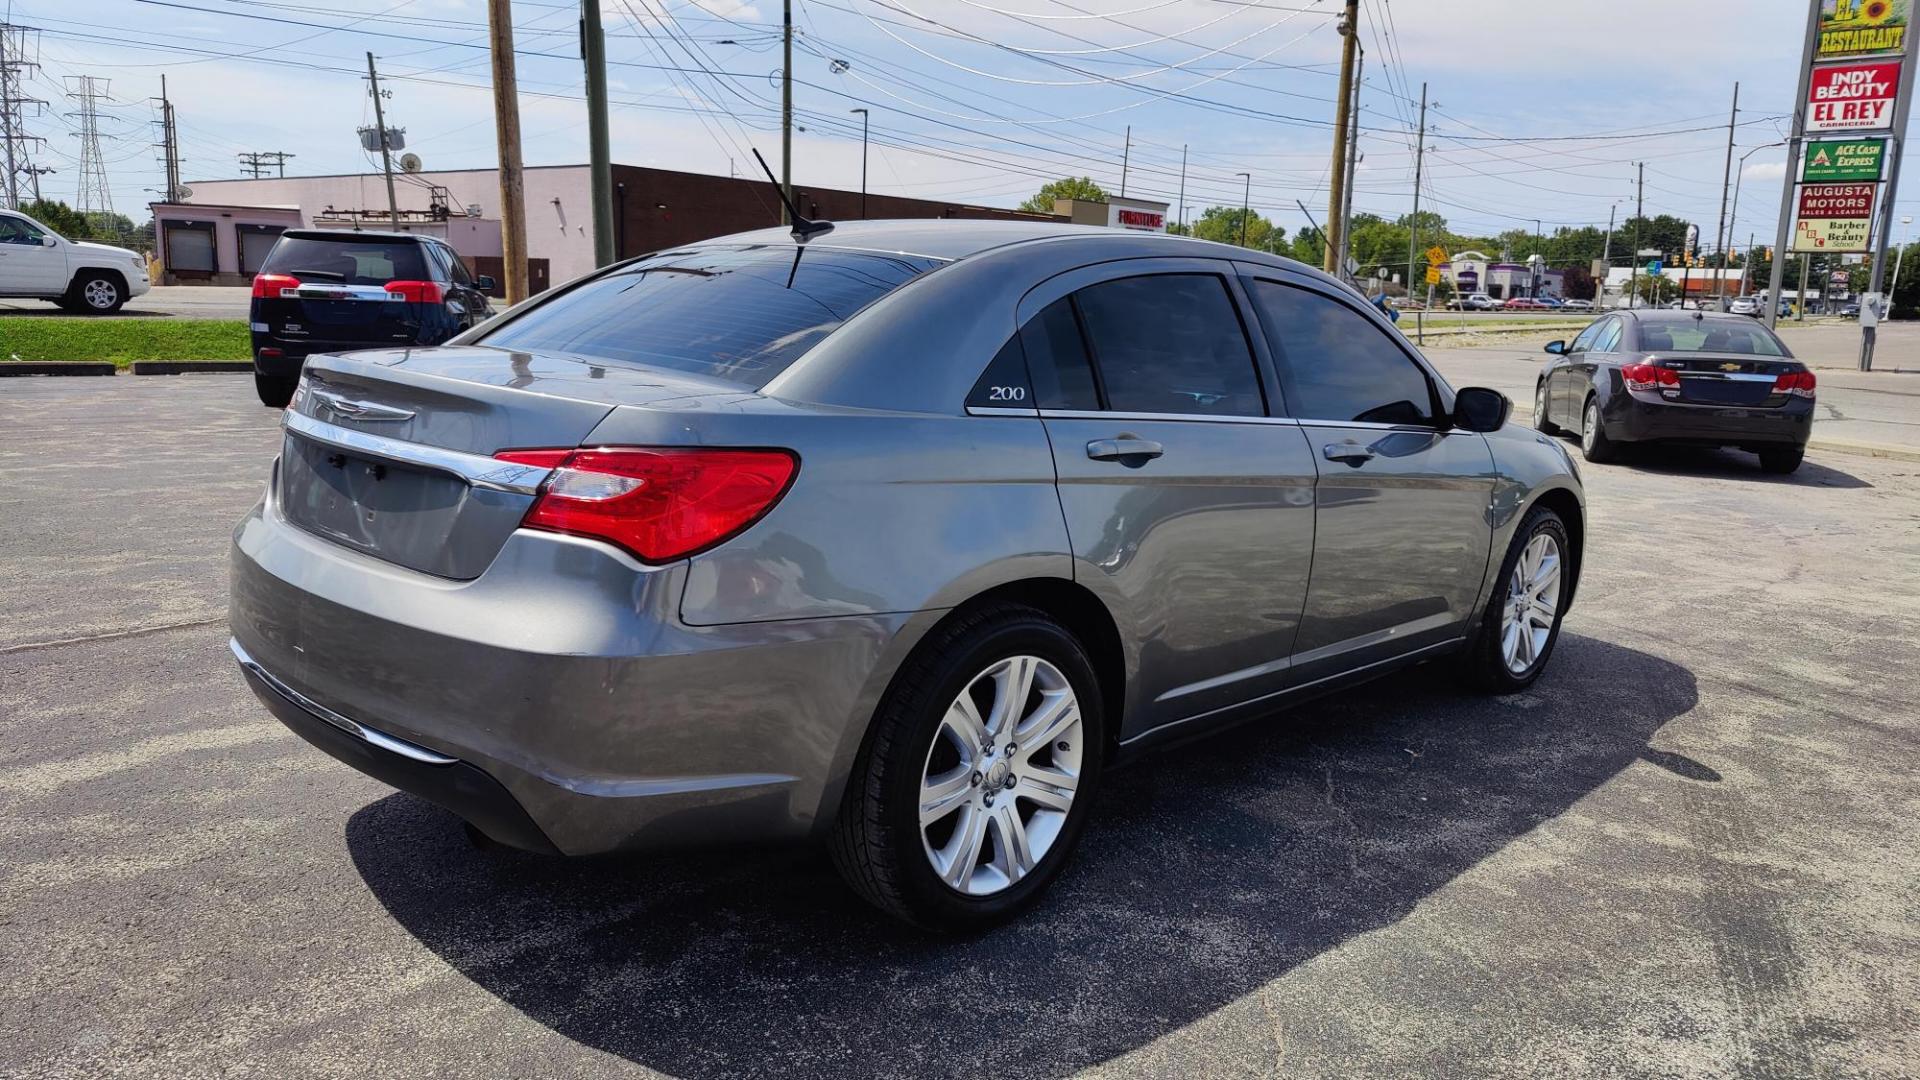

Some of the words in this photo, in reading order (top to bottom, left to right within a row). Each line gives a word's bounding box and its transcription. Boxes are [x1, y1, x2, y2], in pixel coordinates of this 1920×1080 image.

[1835, 0, 1854, 20] EL
[1820, 27, 1905, 53] RESTAURANT
[1831, 70, 1878, 85] INDY
[1816, 82, 1890, 99] BEAUTY
[1814, 103, 1835, 121] EL
[1842, 101, 1885, 120] REY
[1835, 145, 1855, 156] ACE
[1804, 187, 1872, 196] AUGUSTA
[1806, 199, 1866, 208] MOTORS
[1119, 210, 1163, 228] FURNITURE
[1830, 221, 1867, 229] Barber
[1828, 233, 1865, 242] Beauty
[989, 386, 1025, 400] 200
